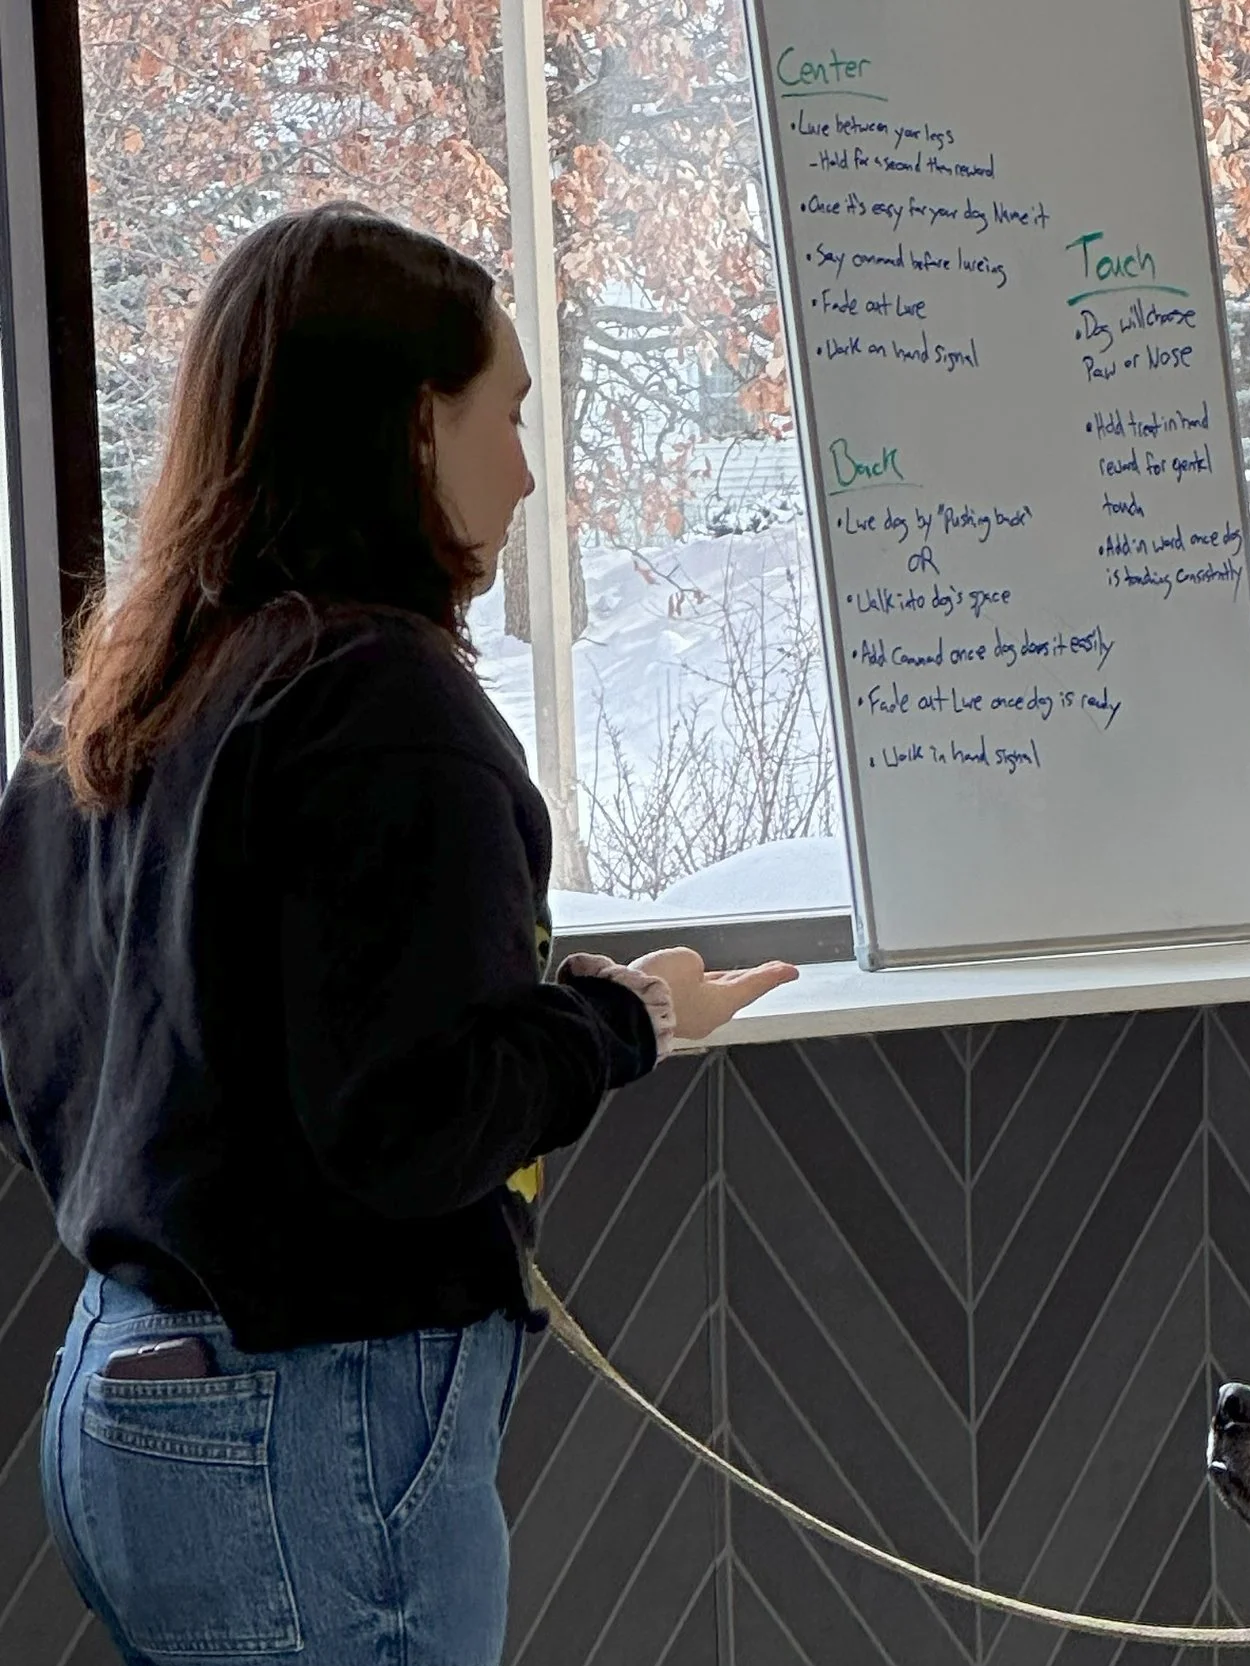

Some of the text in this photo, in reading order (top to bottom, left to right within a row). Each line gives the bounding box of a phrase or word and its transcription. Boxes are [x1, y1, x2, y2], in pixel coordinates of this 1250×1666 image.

[777, 47, 872, 86] Center
[835, 113, 888, 135] between
[895, 127, 921, 149] your
[925, 124, 954, 150] legs
[819, 149, 849, 170] Hold
[855, 147, 868, 170] for
[884, 152, 921, 173] second
[809, 194, 840, 214] Once
[872, 203, 903, 231] easy
[909, 197, 925, 217] for
[930, 208, 958, 225] your
[964, 198, 989, 234] dog
[1032, 202, 1049, 228] it
[816, 243, 845, 279] Say
[910, 250, 950, 270] before
[1066, 231, 1156, 280] Touch
[822, 289, 858, 315] Fade
[866, 292, 892, 315] out
[1081, 310, 1114, 353] Dog
[1120, 298, 1145, 333] will
[868, 344, 887, 357] on
[892, 330, 929, 363] hand
[1083, 344, 1192, 381] Paw or Nose
[1161, 416, 1177, 431] in
[1176, 400, 1209, 429] hand
[830, 438, 904, 487] Back
[1146, 451, 1166, 475] for
[1103, 491, 1144, 517] touch
[884, 506, 908, 543] dog
[915, 508, 932, 542] by
[1106, 534, 1131, 556] Add
[1152, 524, 1185, 552] word
[1190, 531, 1218, 546] once
[1223, 520, 1242, 556] dog
[908, 546, 940, 575] OR
[1106, 568, 1120, 587] is
[857, 584, 1011, 618] Walk into dog's space
[862, 639, 887, 667] Add
[950, 648, 985, 665] once
[995, 627, 1017, 667] dog
[1052, 632, 1069, 655] it
[868, 682, 909, 715] Fade
[918, 686, 949, 711] out
[991, 694, 1024, 710] once
[1027, 686, 1053, 721] dog
[1059, 692, 1073, 708] is
[1080, 687, 1122, 730] ready
[930, 746, 946, 764] in
[951, 735, 990, 766] hand
